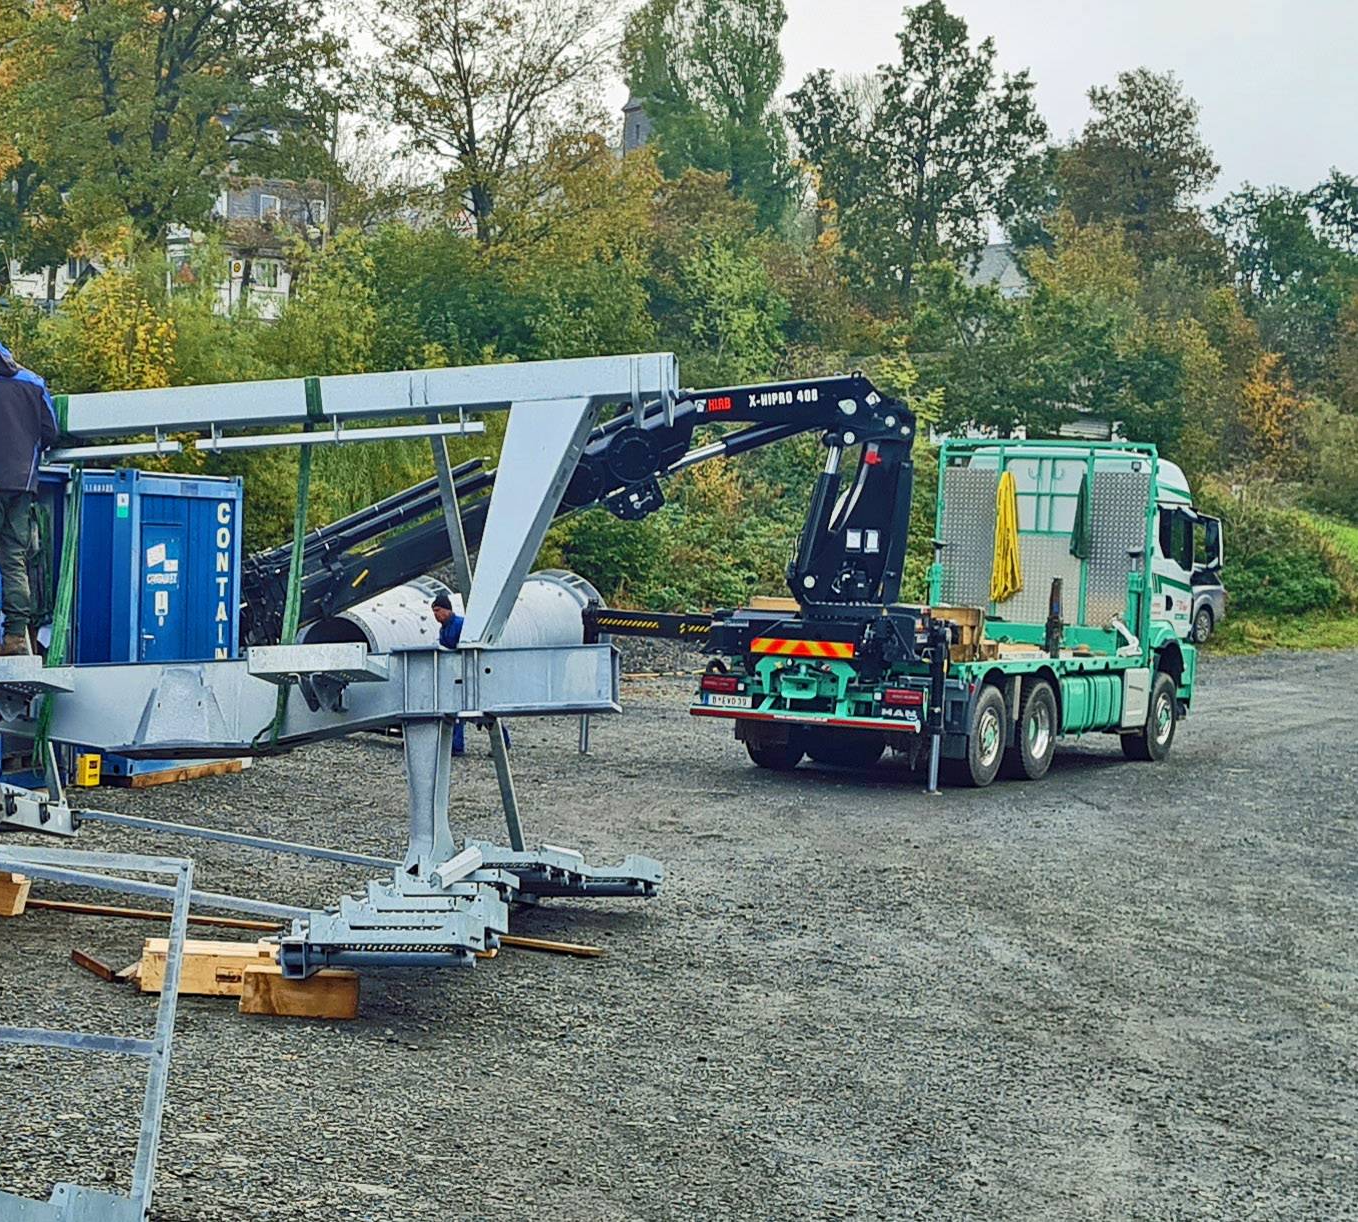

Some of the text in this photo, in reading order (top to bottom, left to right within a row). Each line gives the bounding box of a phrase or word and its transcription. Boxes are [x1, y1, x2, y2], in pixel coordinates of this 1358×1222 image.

[748, 388, 819, 408] X-HIPRO 408
[882, 708, 917, 717] MAN
